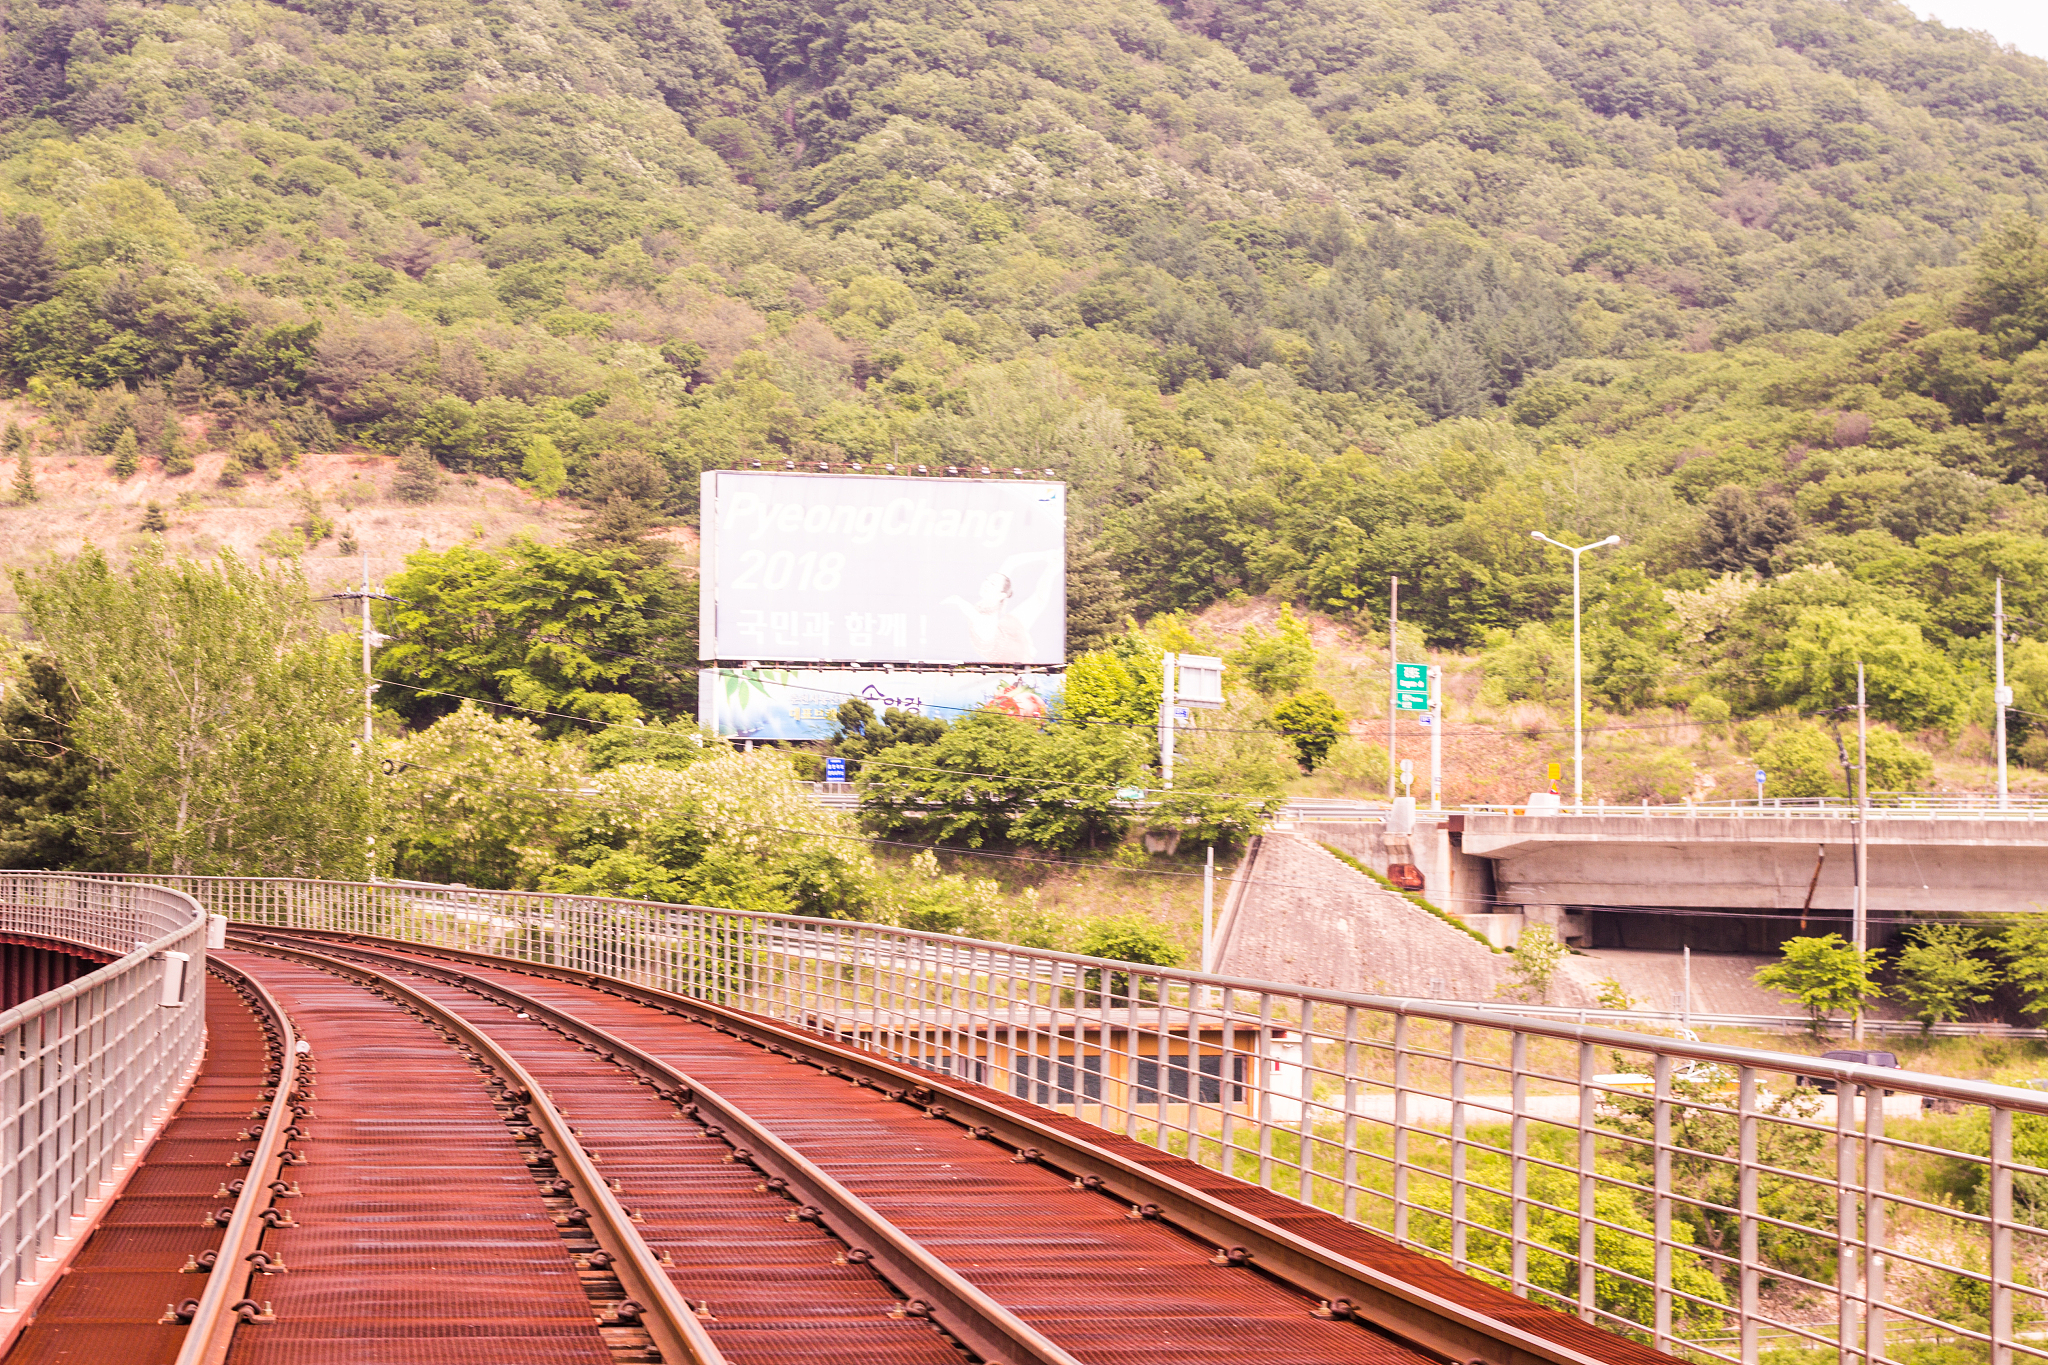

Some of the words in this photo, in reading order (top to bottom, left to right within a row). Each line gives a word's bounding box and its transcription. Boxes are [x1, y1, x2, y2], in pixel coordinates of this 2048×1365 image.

[722, 491, 1013, 547] PyeongChang
[732, 549, 846, 591] 2018
[736, 609, 834, 646] 국민과
[845, 611, 908, 648] 함께
